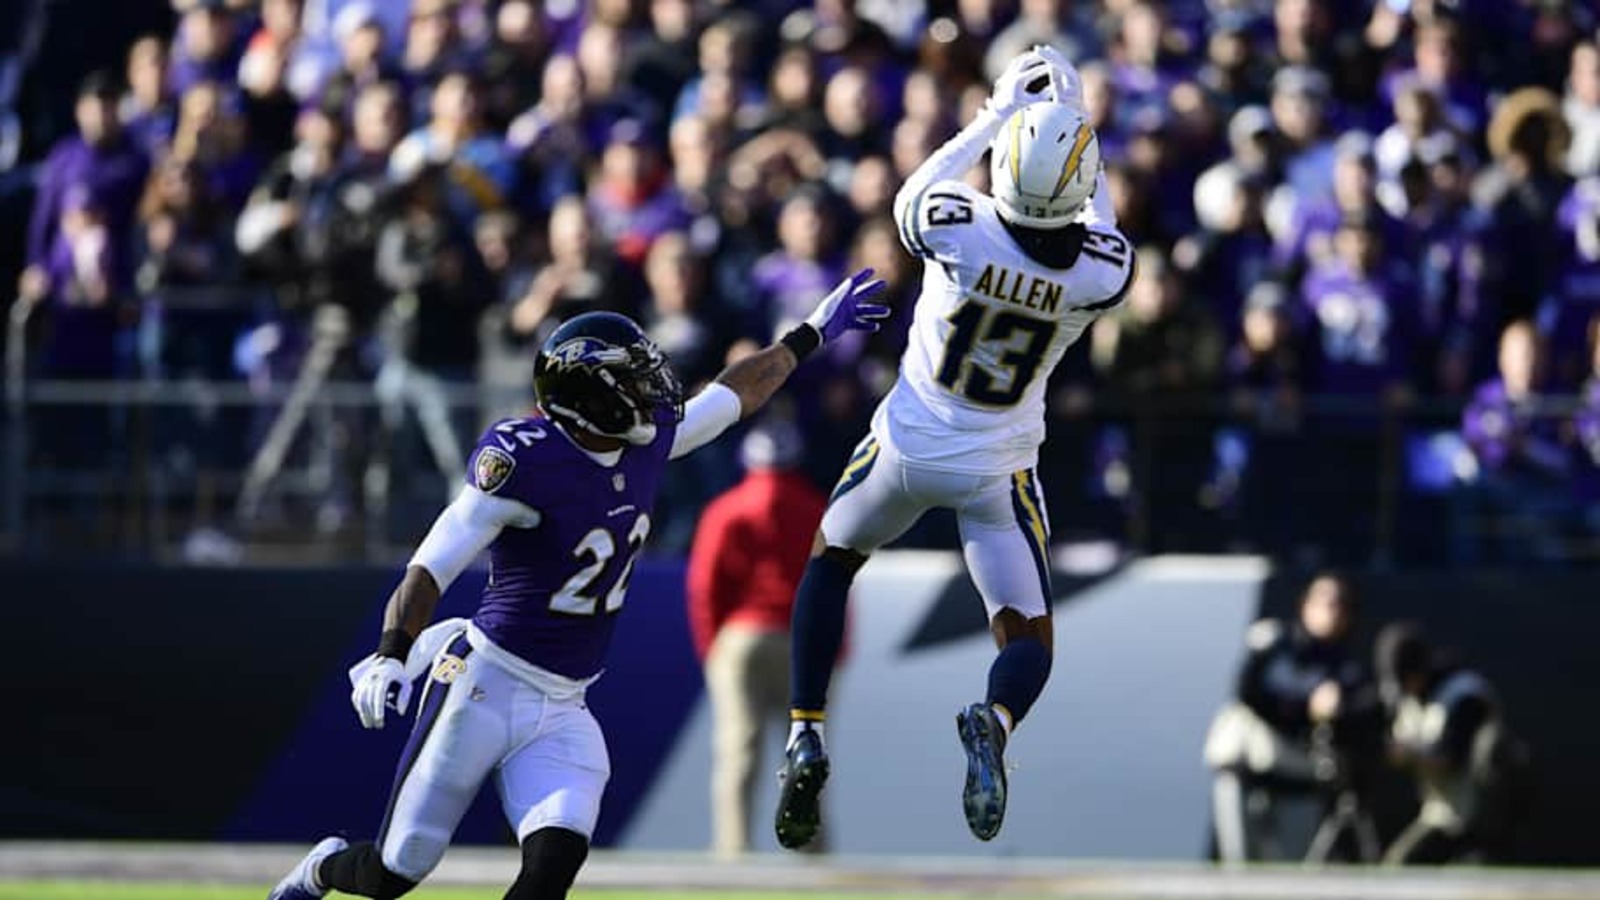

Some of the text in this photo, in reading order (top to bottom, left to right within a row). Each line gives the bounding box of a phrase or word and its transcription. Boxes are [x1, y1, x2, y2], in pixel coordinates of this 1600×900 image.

[974, 263, 1063, 315] ALLEN
[935, 299, 1058, 407] 13
[548, 512, 651, 615] 22
